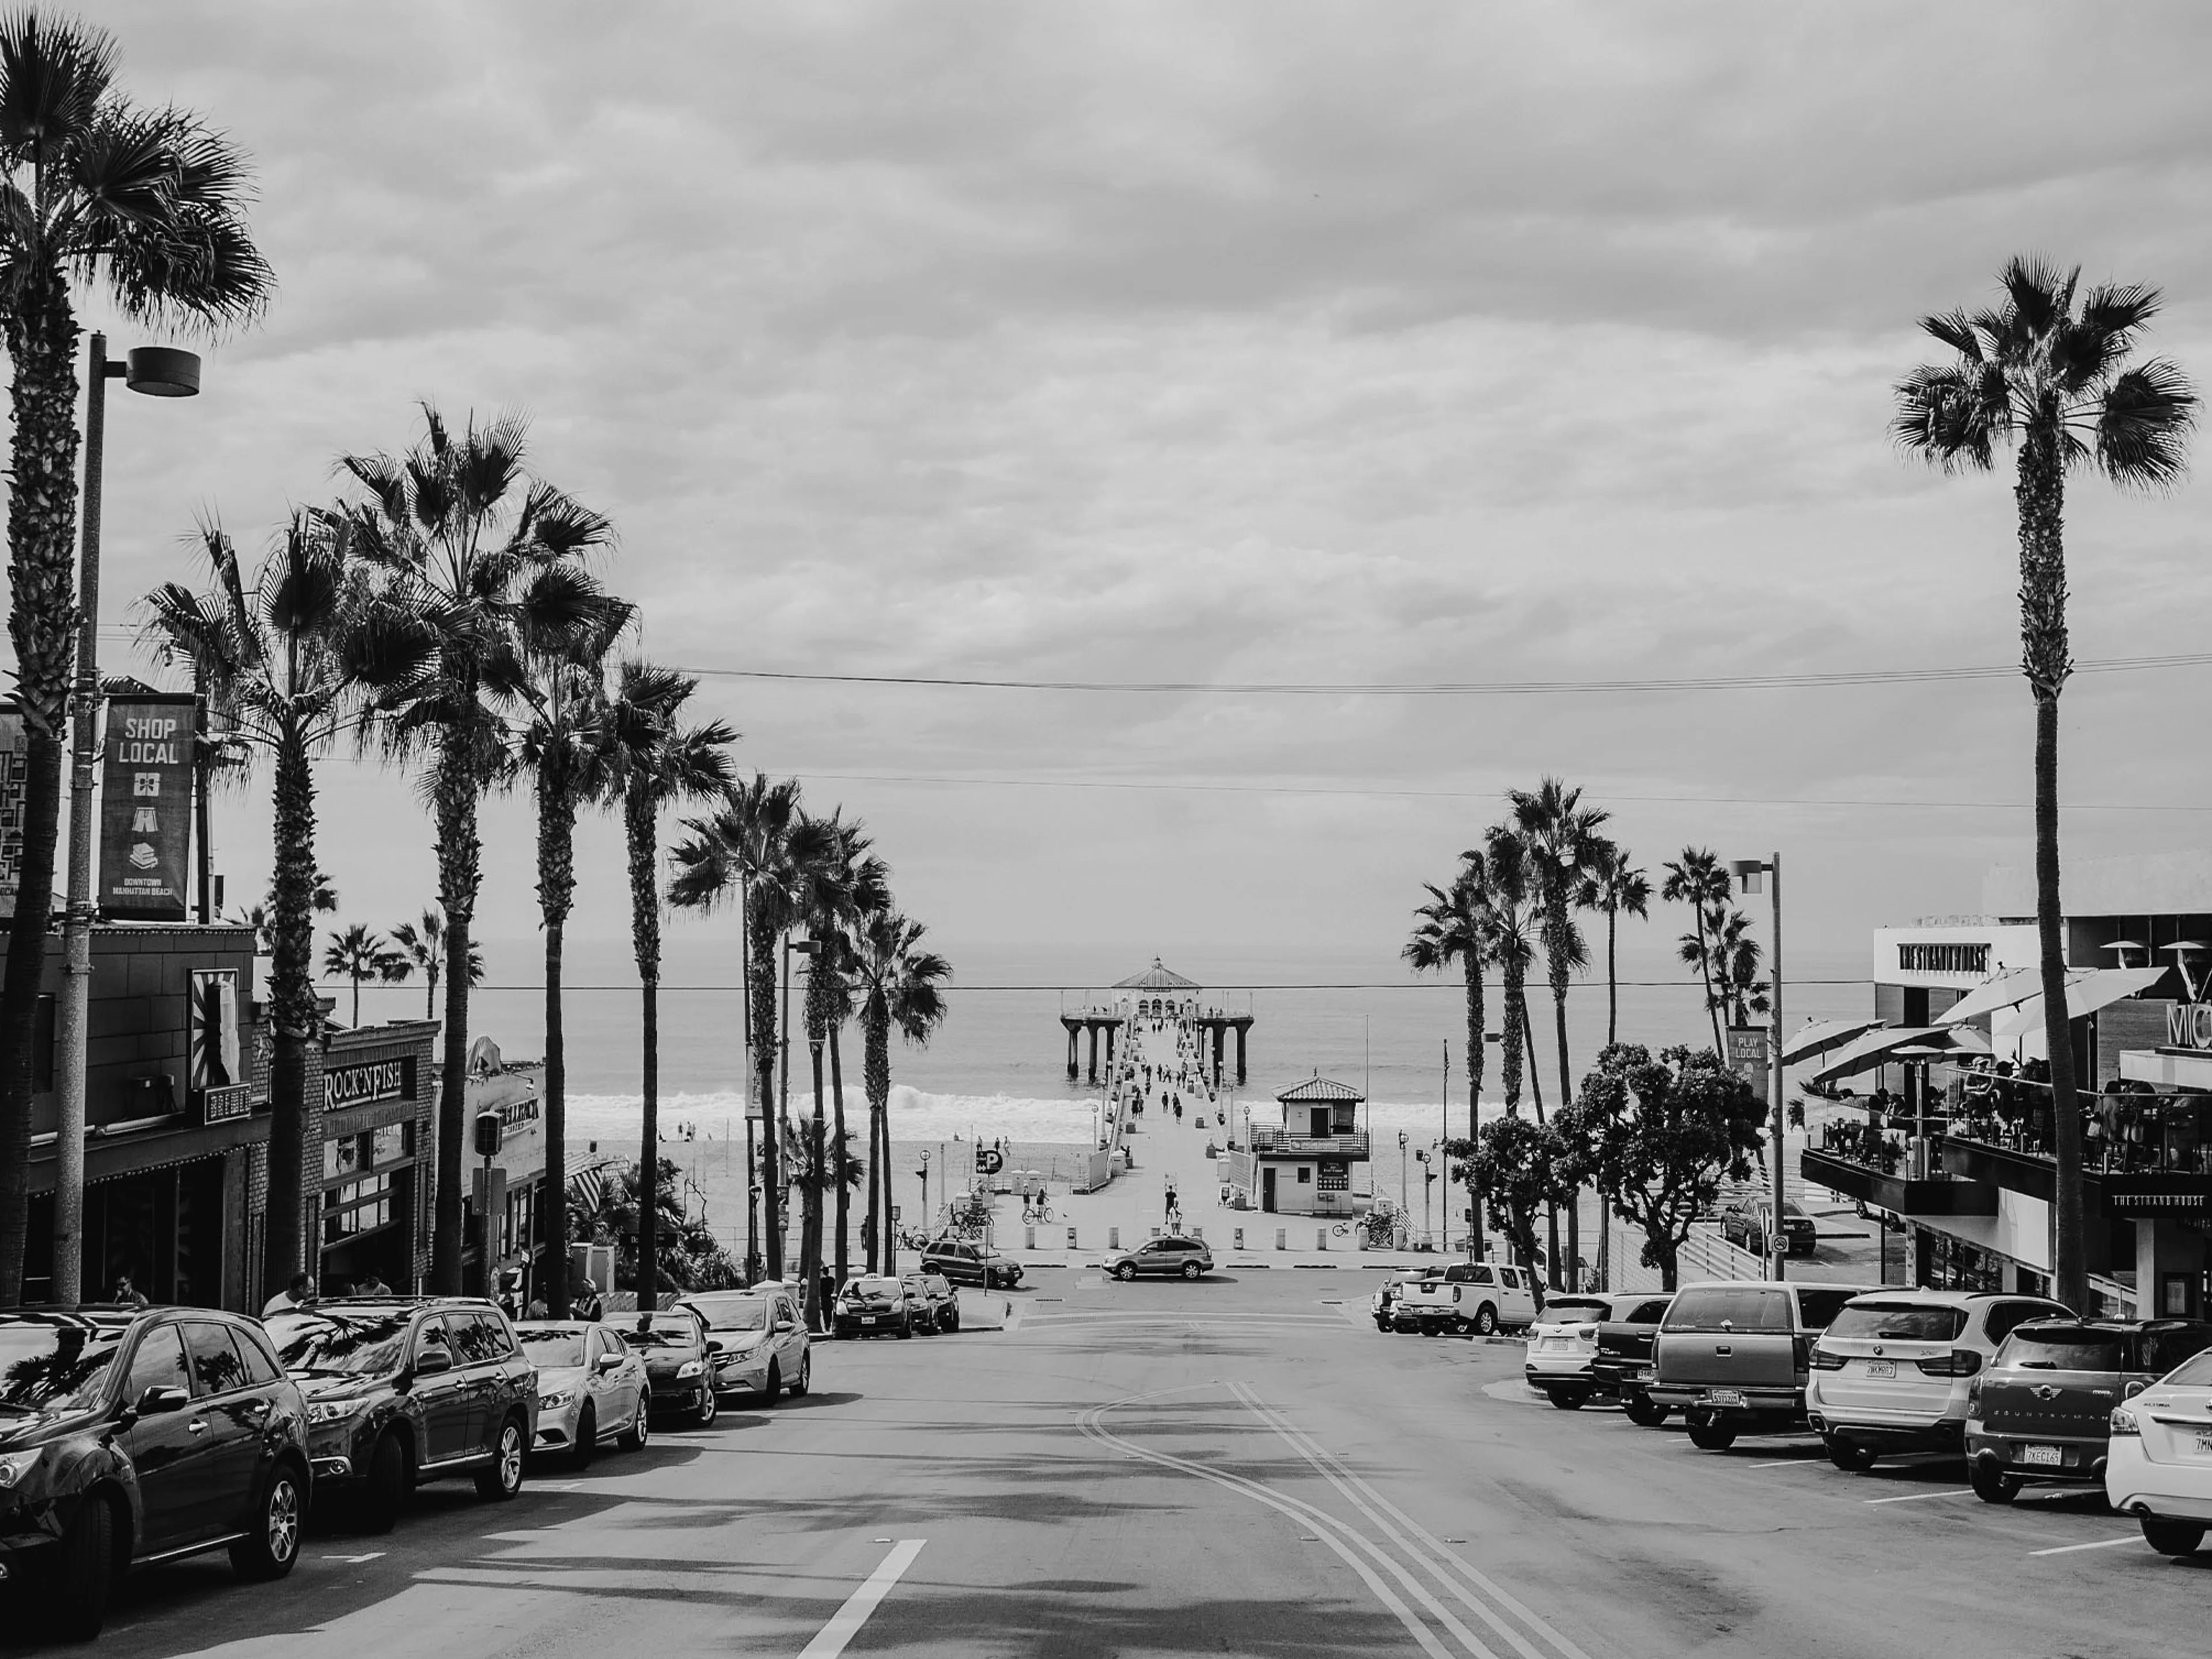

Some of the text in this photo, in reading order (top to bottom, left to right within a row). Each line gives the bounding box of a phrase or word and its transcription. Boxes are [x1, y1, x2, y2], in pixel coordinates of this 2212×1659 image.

[124, 718, 177, 740] SHOP
[118, 742, 179, 764] LOCAL
[124, 878, 162, 887] DOWNTOWN
[113, 887, 173, 896] MANHATTAN BEACH
[1738, 1037, 1759, 1047] PLAY
[1736, 1048, 1762, 1058] LOCAL
[987, 1153, 999, 1169] P
[2113, 1195, 2203, 1206] THE STRAND HOUSE
[1993, 1410, 2108, 1421] COUNTRYMAN
